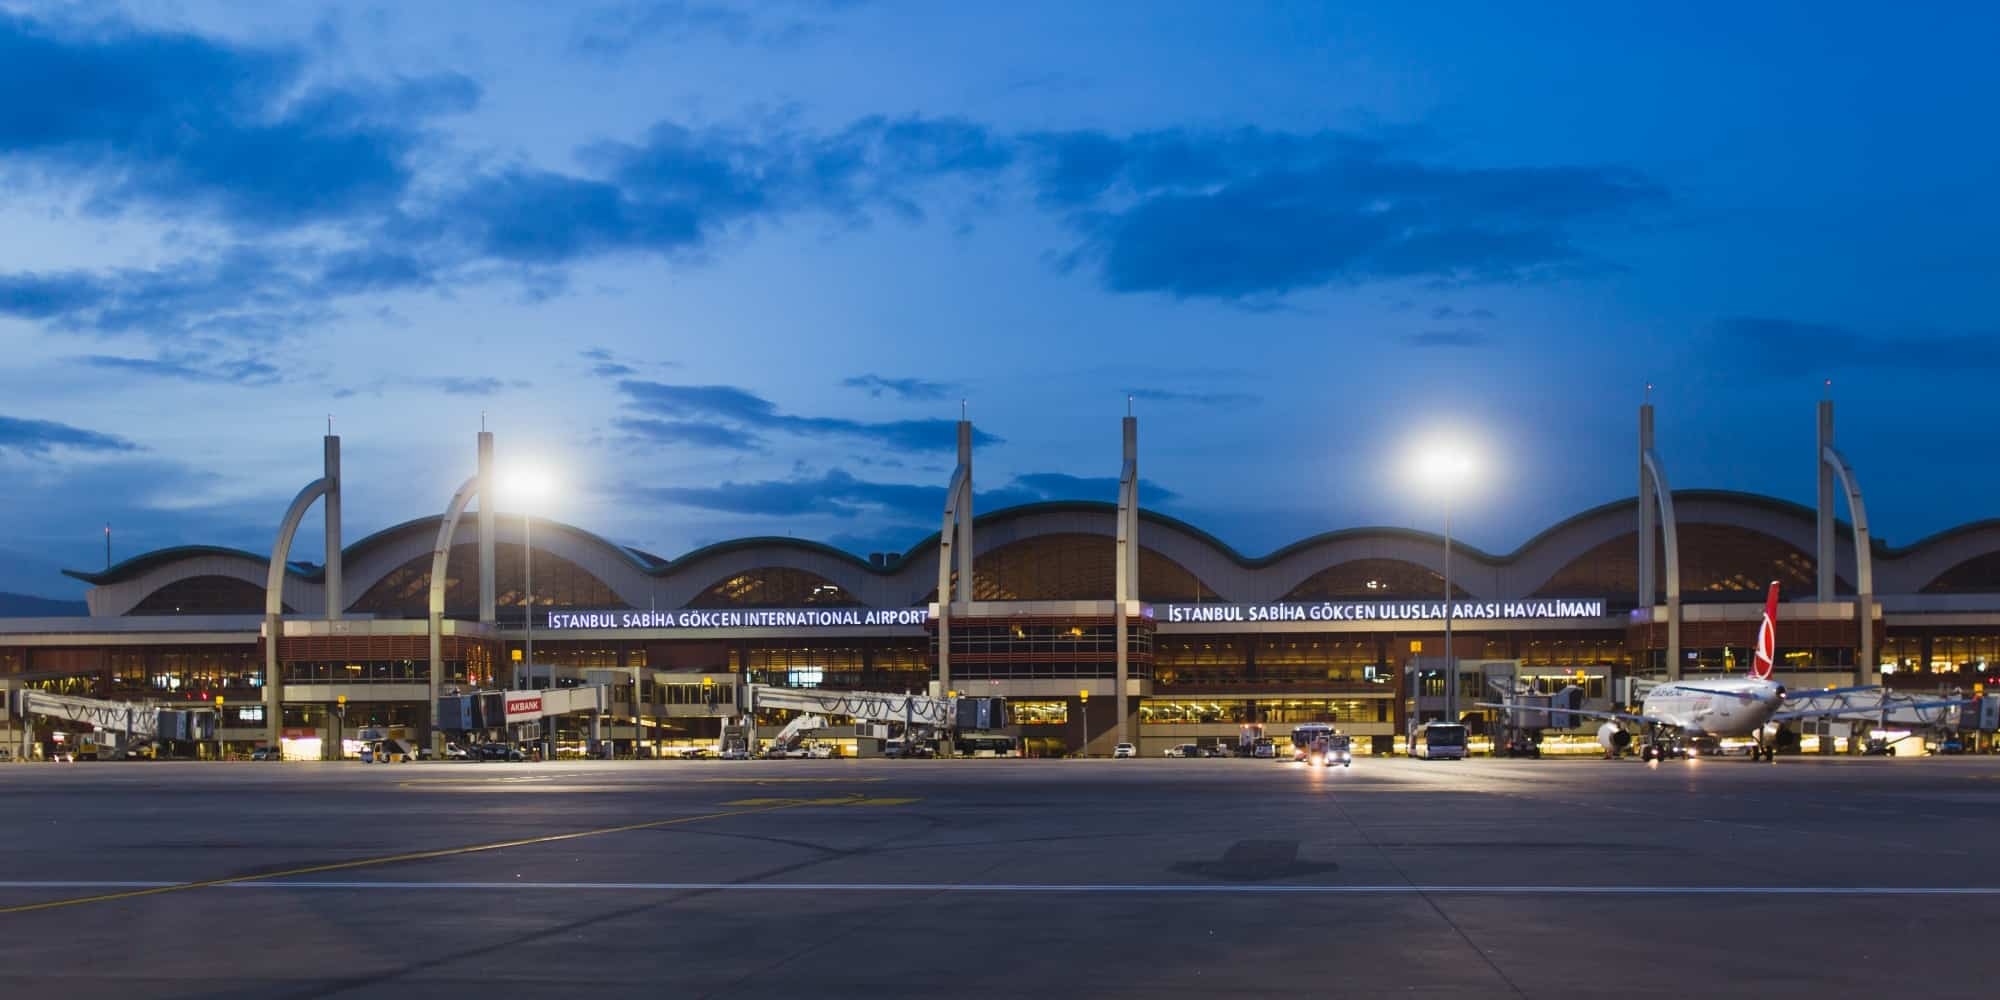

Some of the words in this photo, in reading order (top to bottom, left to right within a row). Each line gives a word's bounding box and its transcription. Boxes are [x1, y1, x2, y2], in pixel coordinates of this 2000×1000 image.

[548, 611, 617, 629] İSTANBUL
[623, 610, 675, 628] SABİHA
[679, 609, 741, 628] GÖKÇEN
[744, 611, 861, 626] INTERNATIONAL
[865, 610, 928, 625] AIRPORT
[1168, 604, 1243, 622] İSTANBUL
[1249, 603, 1306, 621] SABİHA
[1309, 602, 1376, 621] GÖKÇEN
[1504, 599, 1600, 618] HAVALİMANI
[510, 700, 538, 712] AKBANK
